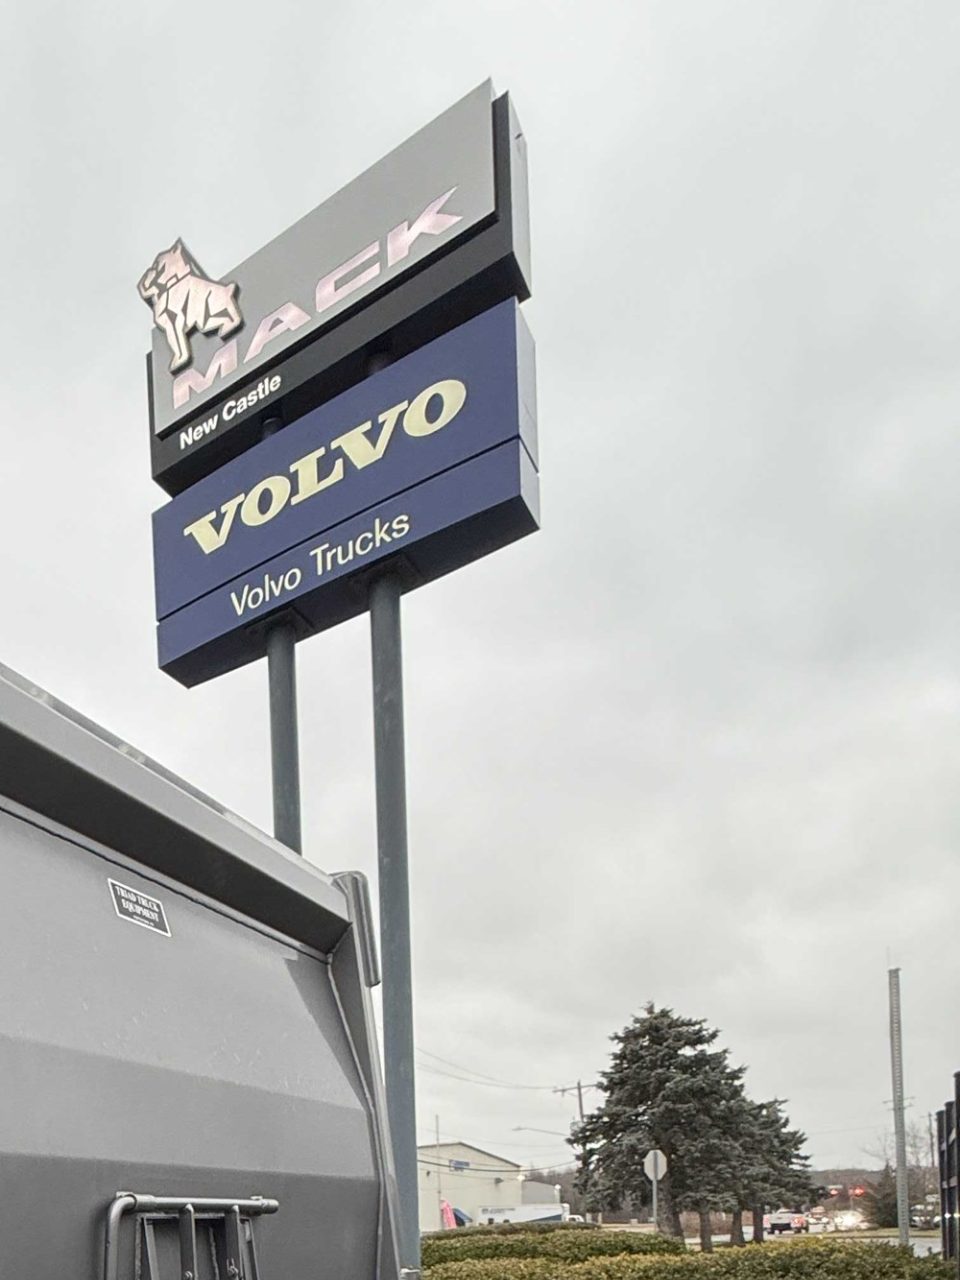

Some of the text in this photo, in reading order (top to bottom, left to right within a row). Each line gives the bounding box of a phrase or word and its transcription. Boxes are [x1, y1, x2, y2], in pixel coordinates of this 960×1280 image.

[172, 185, 464, 410] MACK
[179, 373, 282, 449] New Castle
[183, 378, 467, 556] VOLVO
[230, 512, 411, 616] Volvo Trucks
